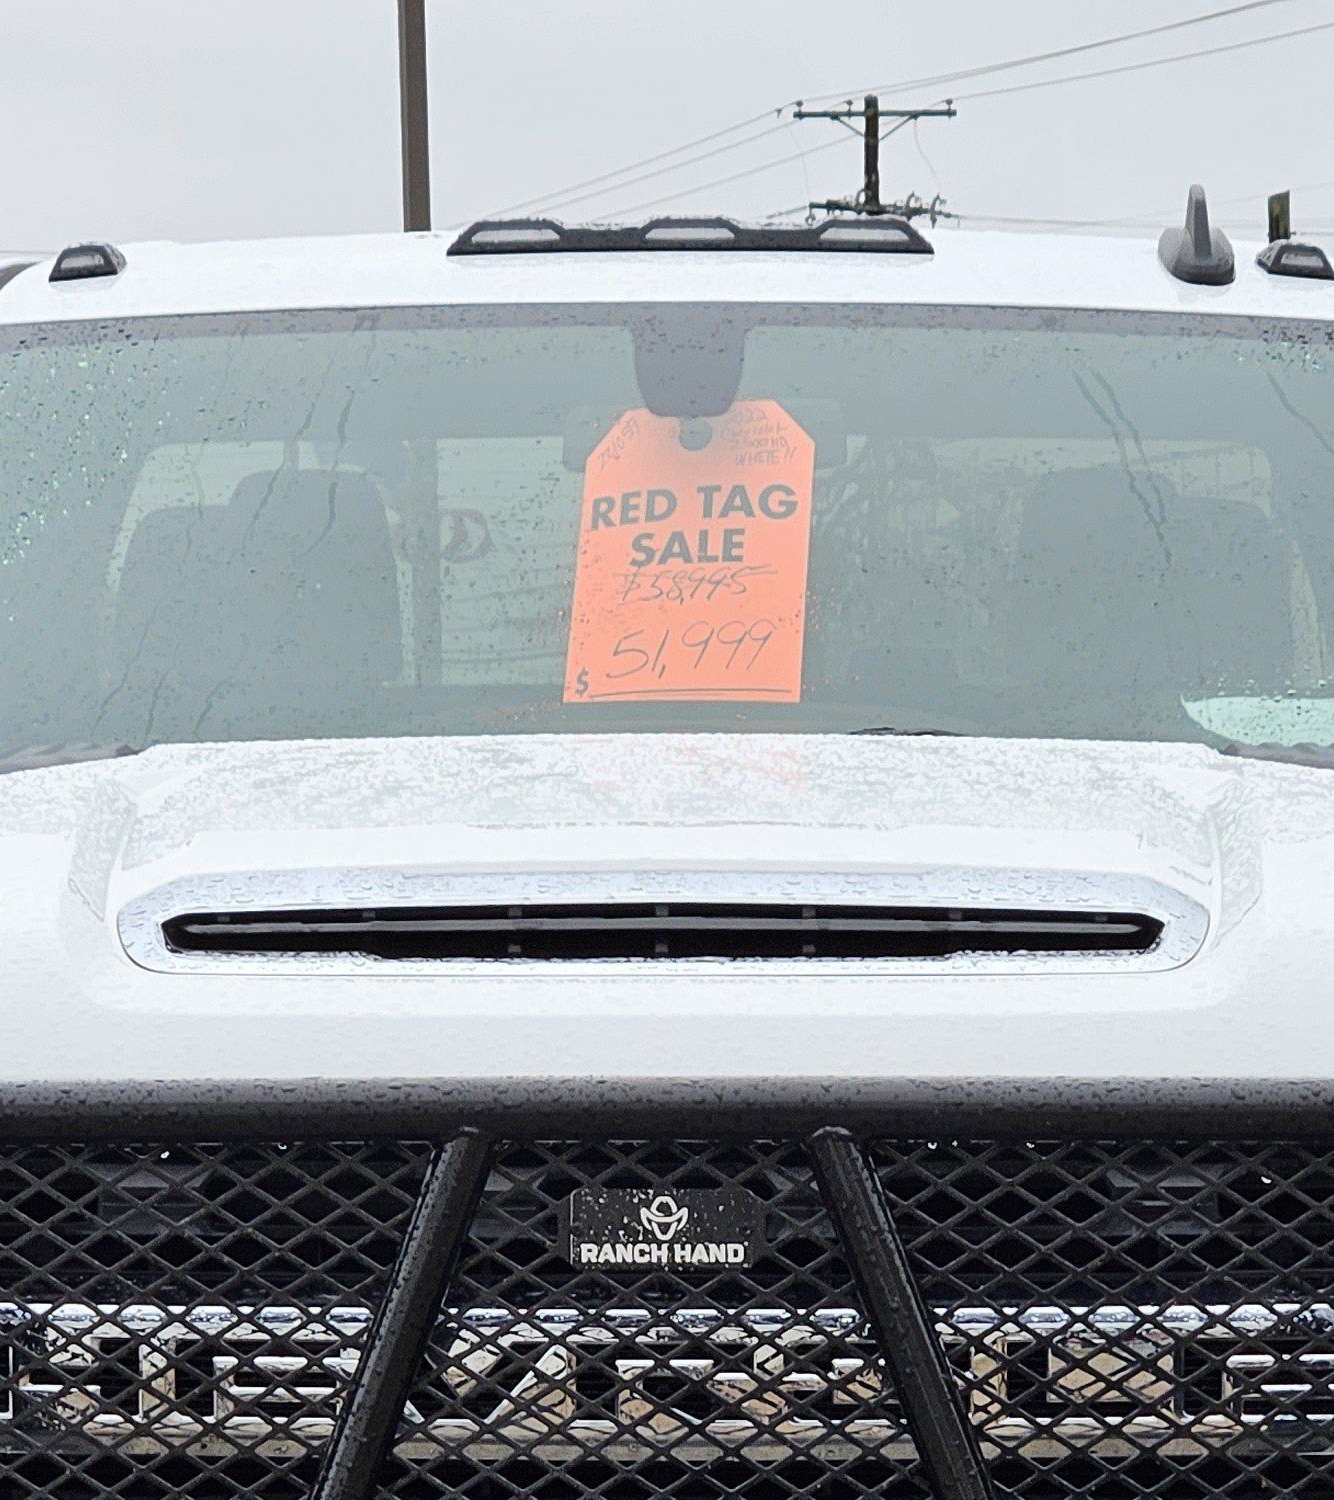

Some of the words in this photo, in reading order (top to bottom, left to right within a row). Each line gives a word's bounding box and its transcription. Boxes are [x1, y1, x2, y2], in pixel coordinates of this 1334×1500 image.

[590, 488, 677, 531] RED
[697, 484, 798, 520] TAG
[630, 528, 746, 568] SALE
[575, 667, 589, 698] $
[605, 619, 777, 679] 51,999
[579, 1242, 669, 1264] RANCH
[673, 1242, 745, 1264] HAND
